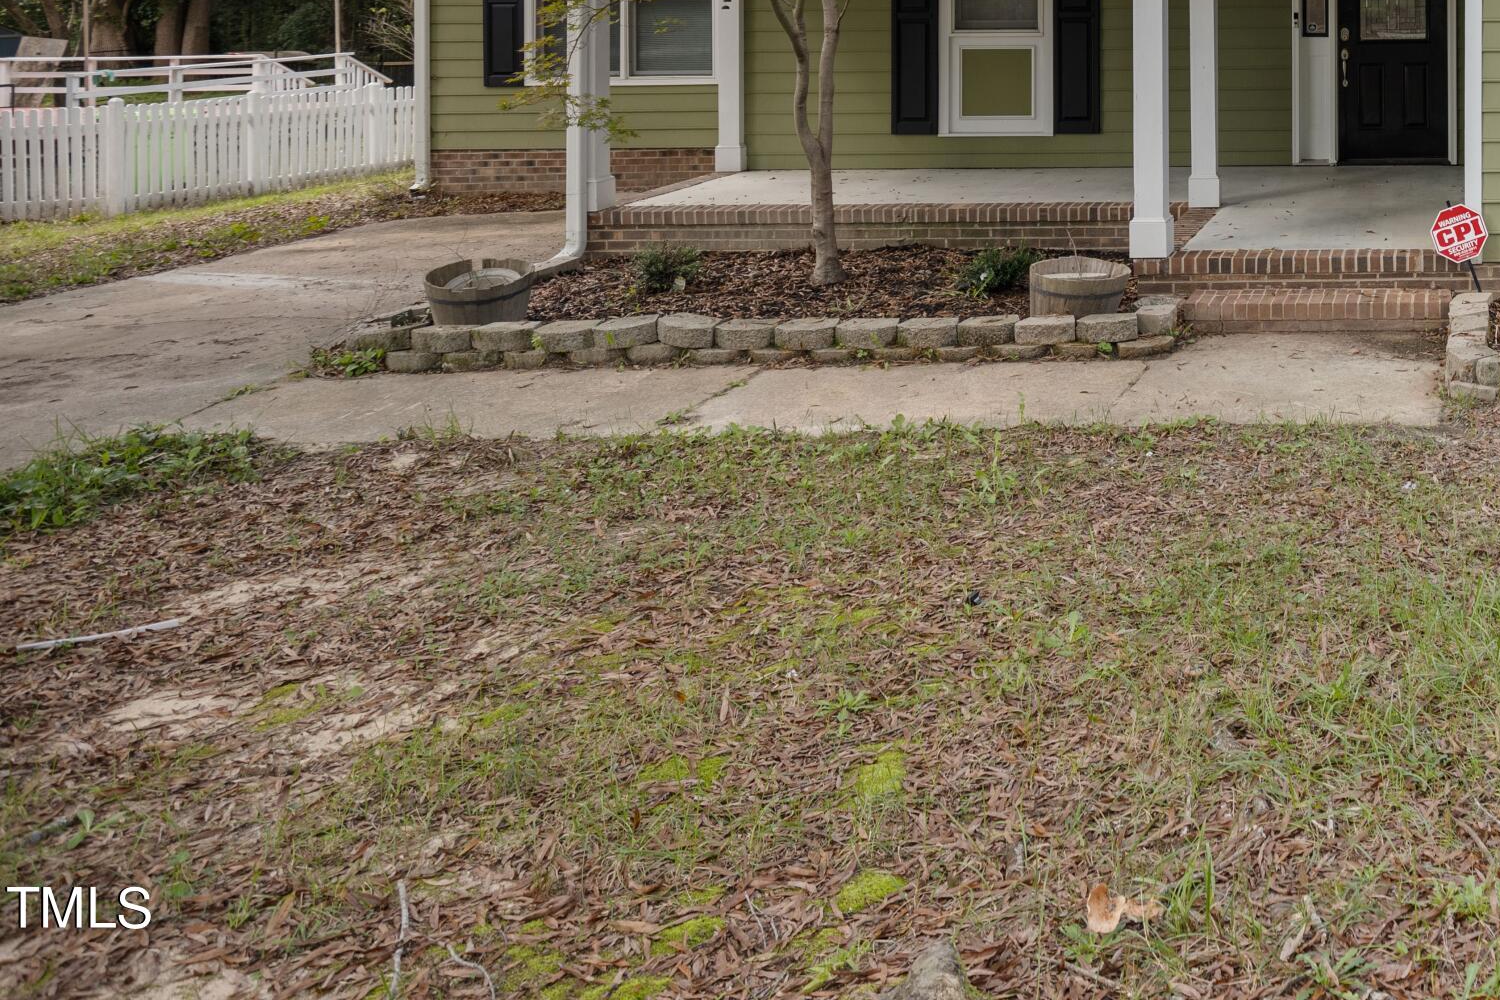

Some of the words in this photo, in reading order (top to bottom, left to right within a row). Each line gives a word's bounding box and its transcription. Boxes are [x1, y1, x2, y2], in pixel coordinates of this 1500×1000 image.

[1438, 211, 1471, 228] WARNING
[1436, 218, 1484, 248] CPI
[1448, 239, 1478, 255] SECURITY
